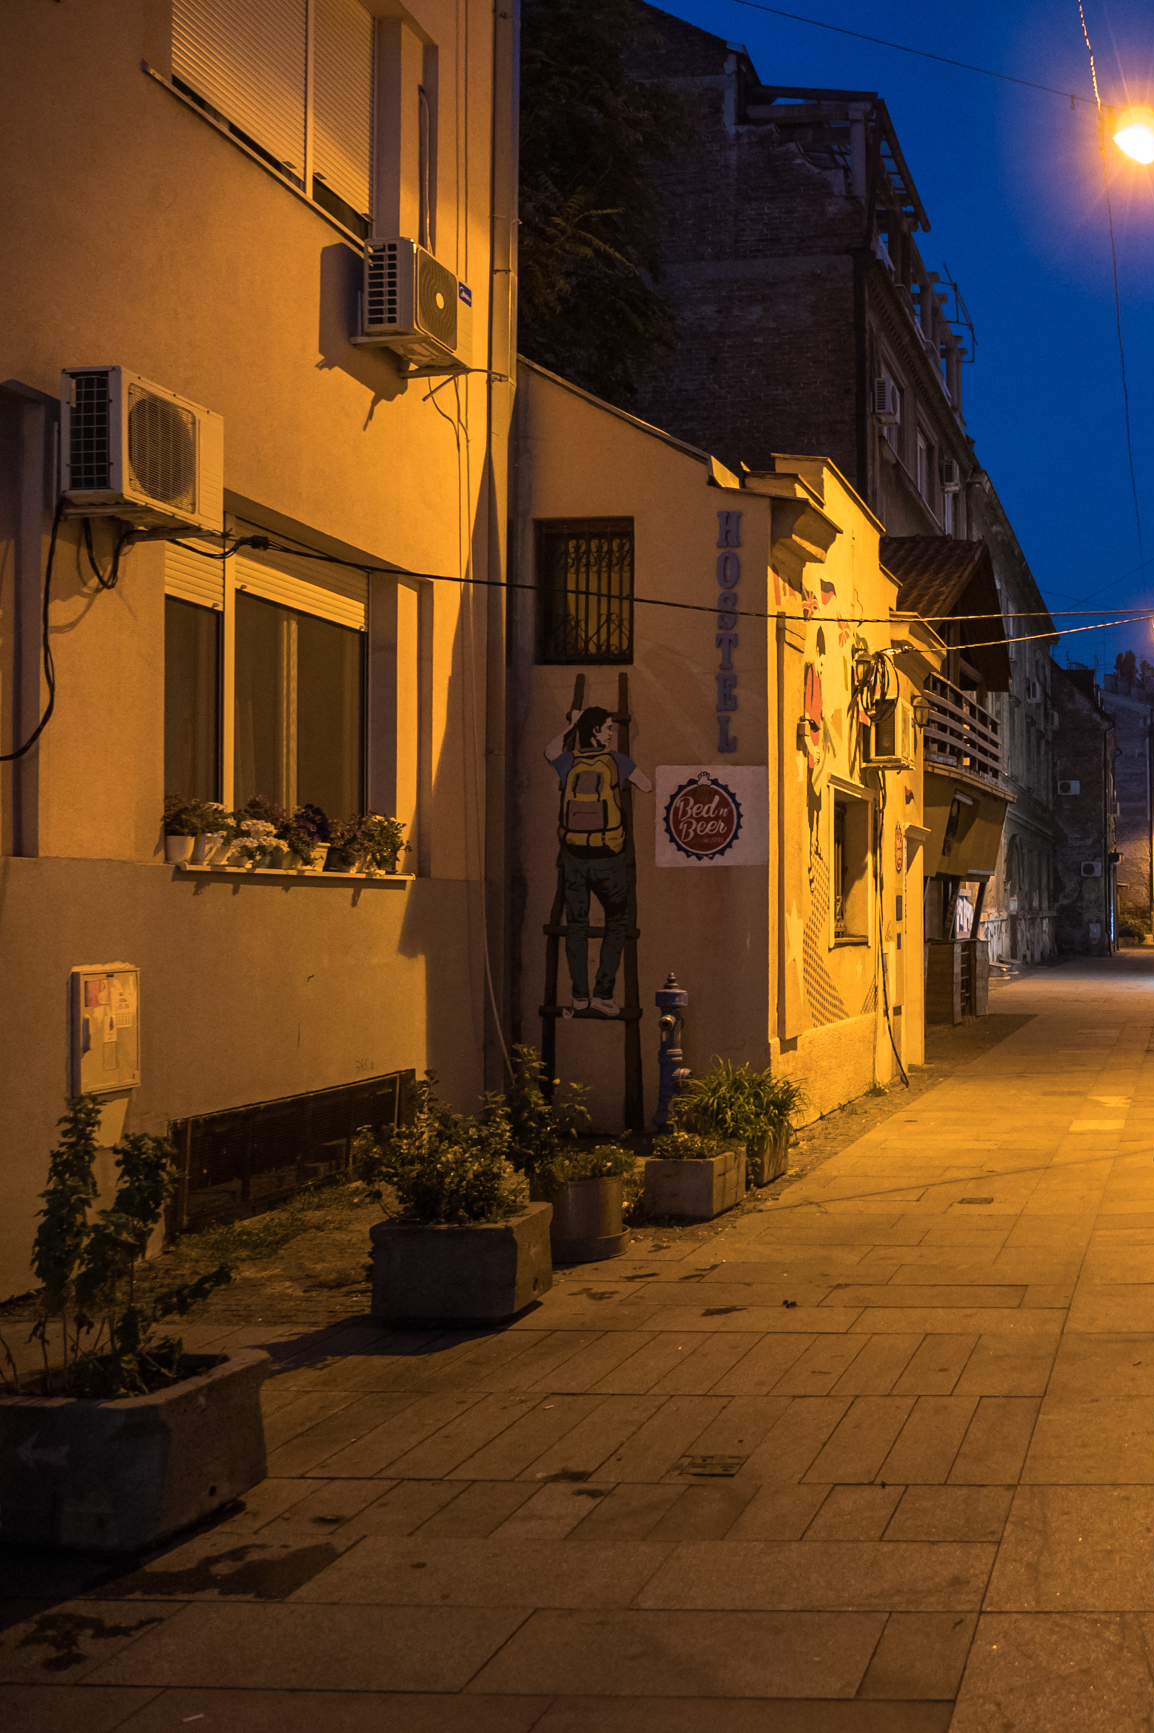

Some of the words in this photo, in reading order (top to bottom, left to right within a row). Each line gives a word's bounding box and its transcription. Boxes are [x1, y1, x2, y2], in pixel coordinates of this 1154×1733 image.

[715, 510, 743, 754] HOSTEL
[676, 795, 719, 820] Bed
[679, 819, 727, 842] Beer
